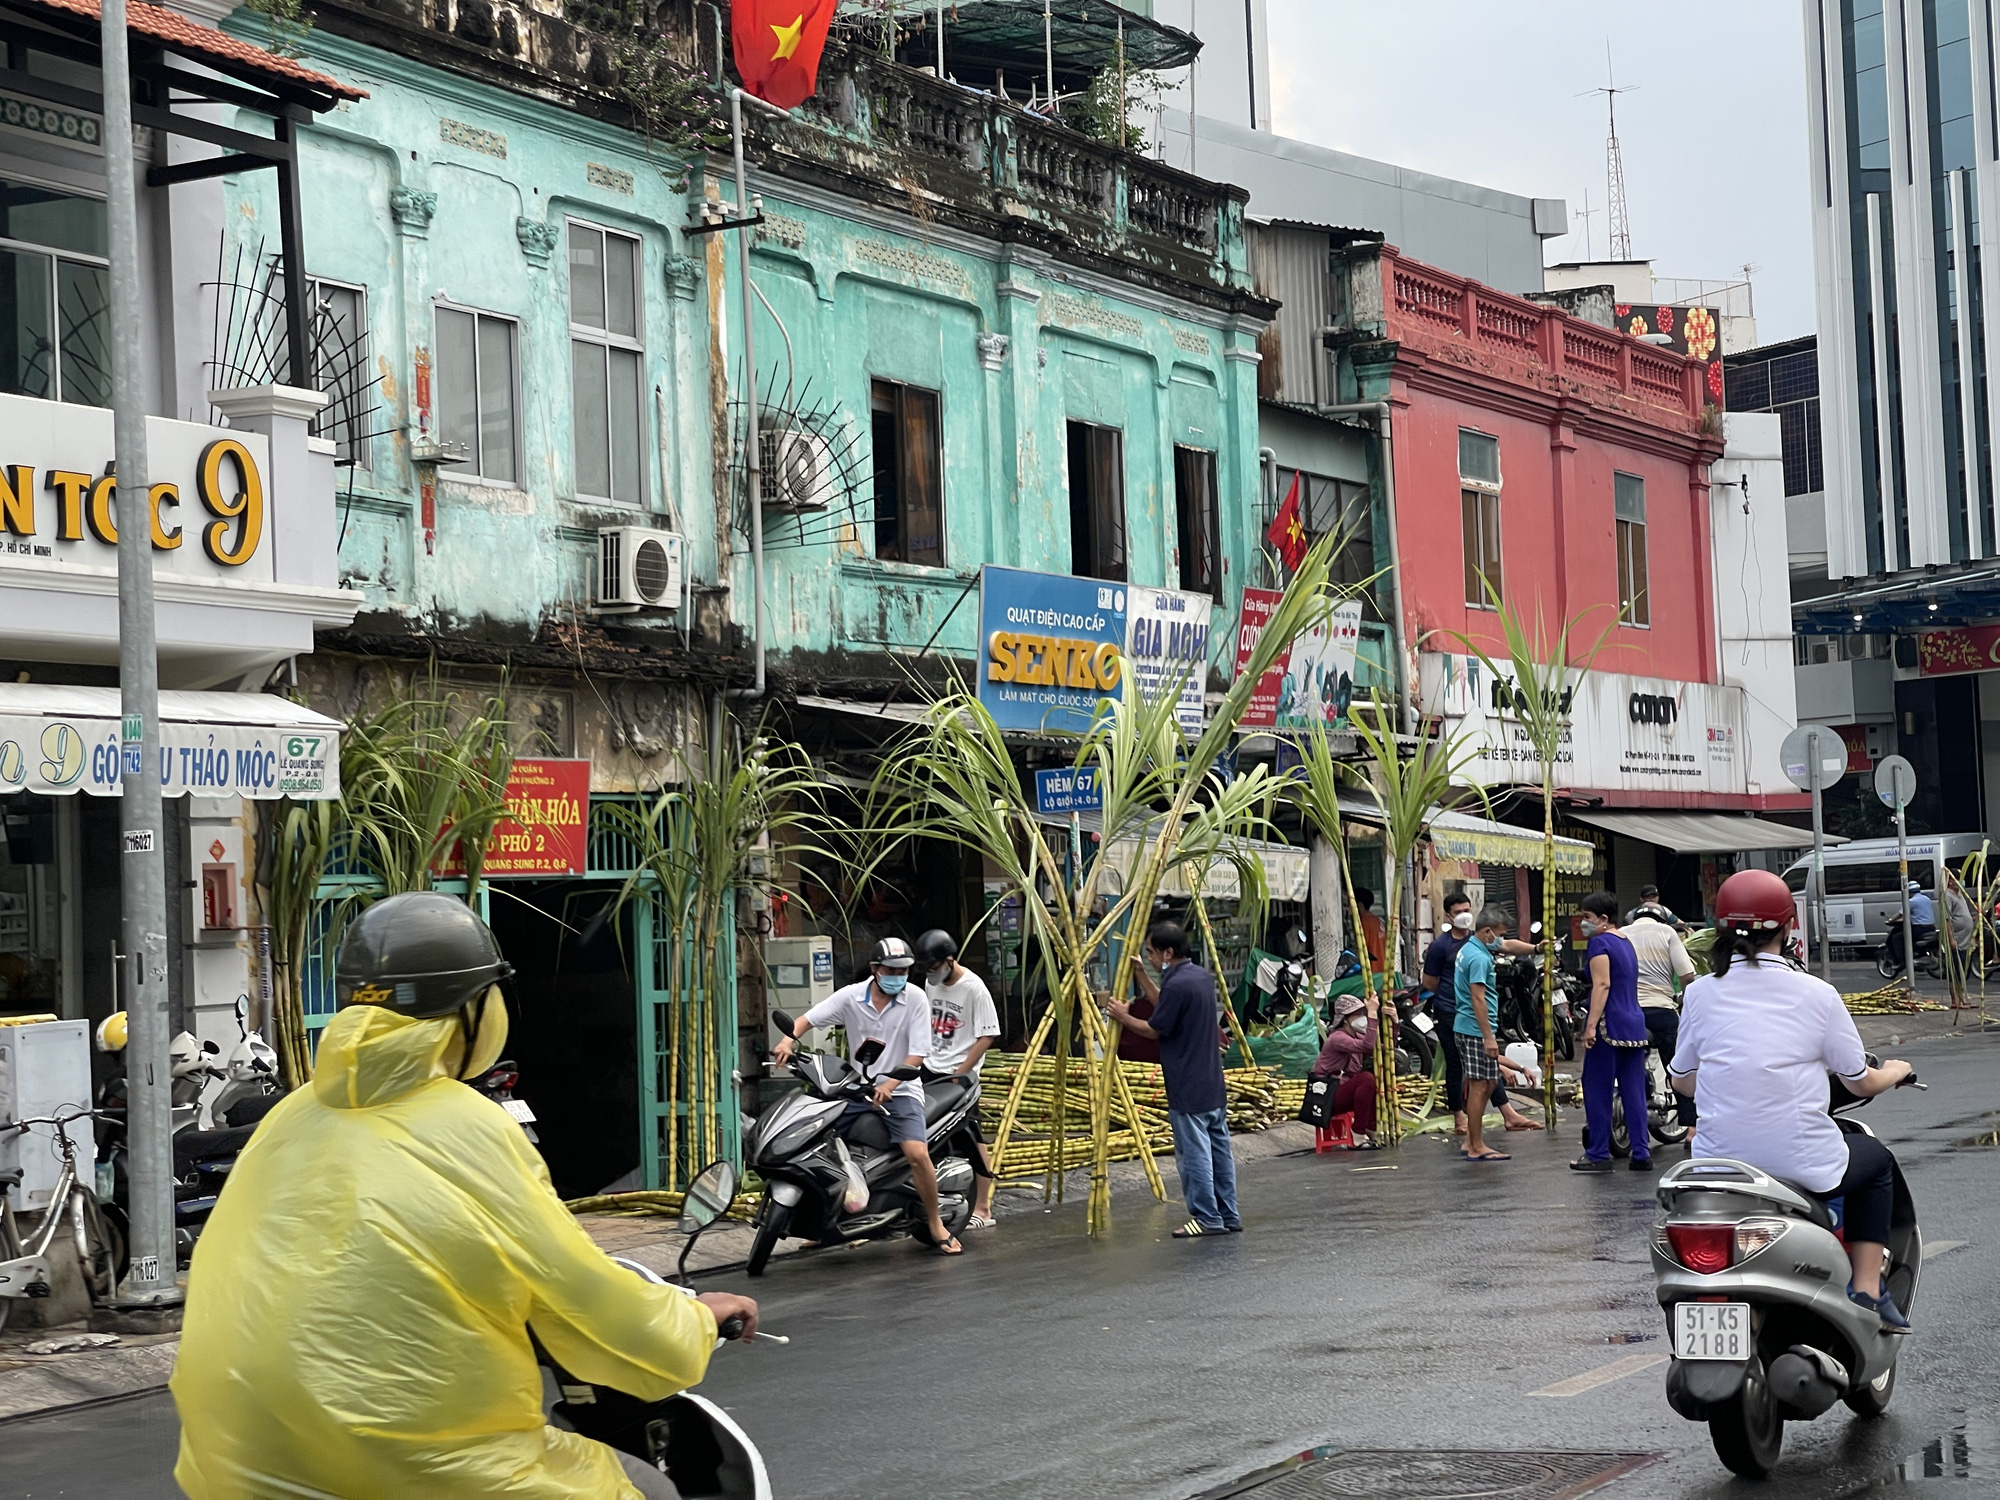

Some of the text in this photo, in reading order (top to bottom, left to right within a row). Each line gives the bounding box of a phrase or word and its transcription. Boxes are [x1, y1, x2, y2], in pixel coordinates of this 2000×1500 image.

[196, 439, 264, 566] 9
[1007, 606, 1106, 631] QUẠT ĐIỆN CAO CẤP
[1134, 617, 1163, 657] GIA
[988, 630, 1121, 691] SENKO
[1039, 693, 1056, 705] CHO
[1707, 728, 1717, 742] 3M
[40, 723, 87, 786] 9
[288, 737, 321, 757] 67
[179, 734, 229, 787] THẢO
[235, 740, 276, 795] MỘC
[1045, 772, 1092, 793] HẺM 67
[547, 791, 582, 825] HÓA
[535, 835, 545, 852] 2
[484, 859, 511, 871] QUANG
[513, 859, 534, 870] SUNG
[553, 858, 567, 870] Q.6
[1686, 1333, 1738, 1355] 2188
